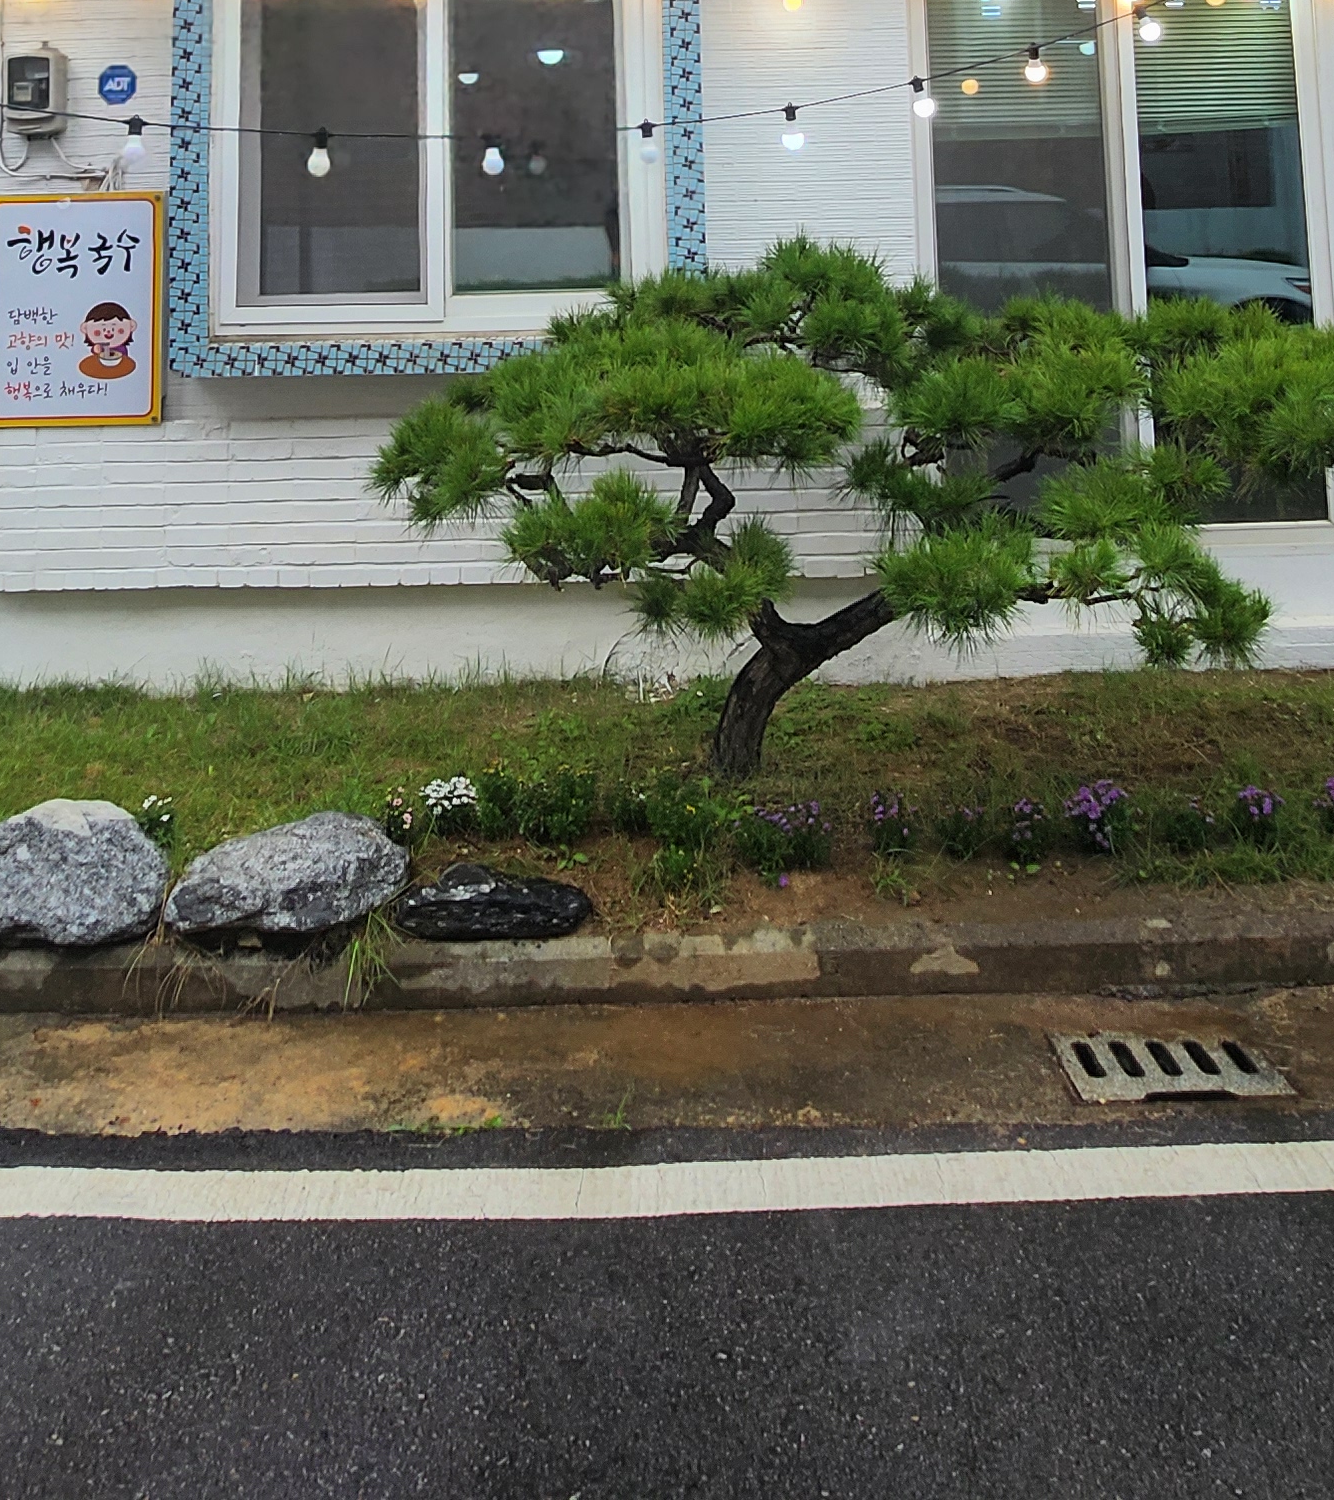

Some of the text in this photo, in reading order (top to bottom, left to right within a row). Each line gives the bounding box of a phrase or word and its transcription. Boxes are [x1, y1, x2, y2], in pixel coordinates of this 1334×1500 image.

[103, 77, 131, 91] ADT
[7, 225, 141, 279] 행복 국수
[8, 307, 58, 326] 담백한
[7, 331, 75, 350] 고향의 맛!
[6, 356, 52, 376] 입 안을
[4, 380, 108, 401] 행복으로 채우다!
